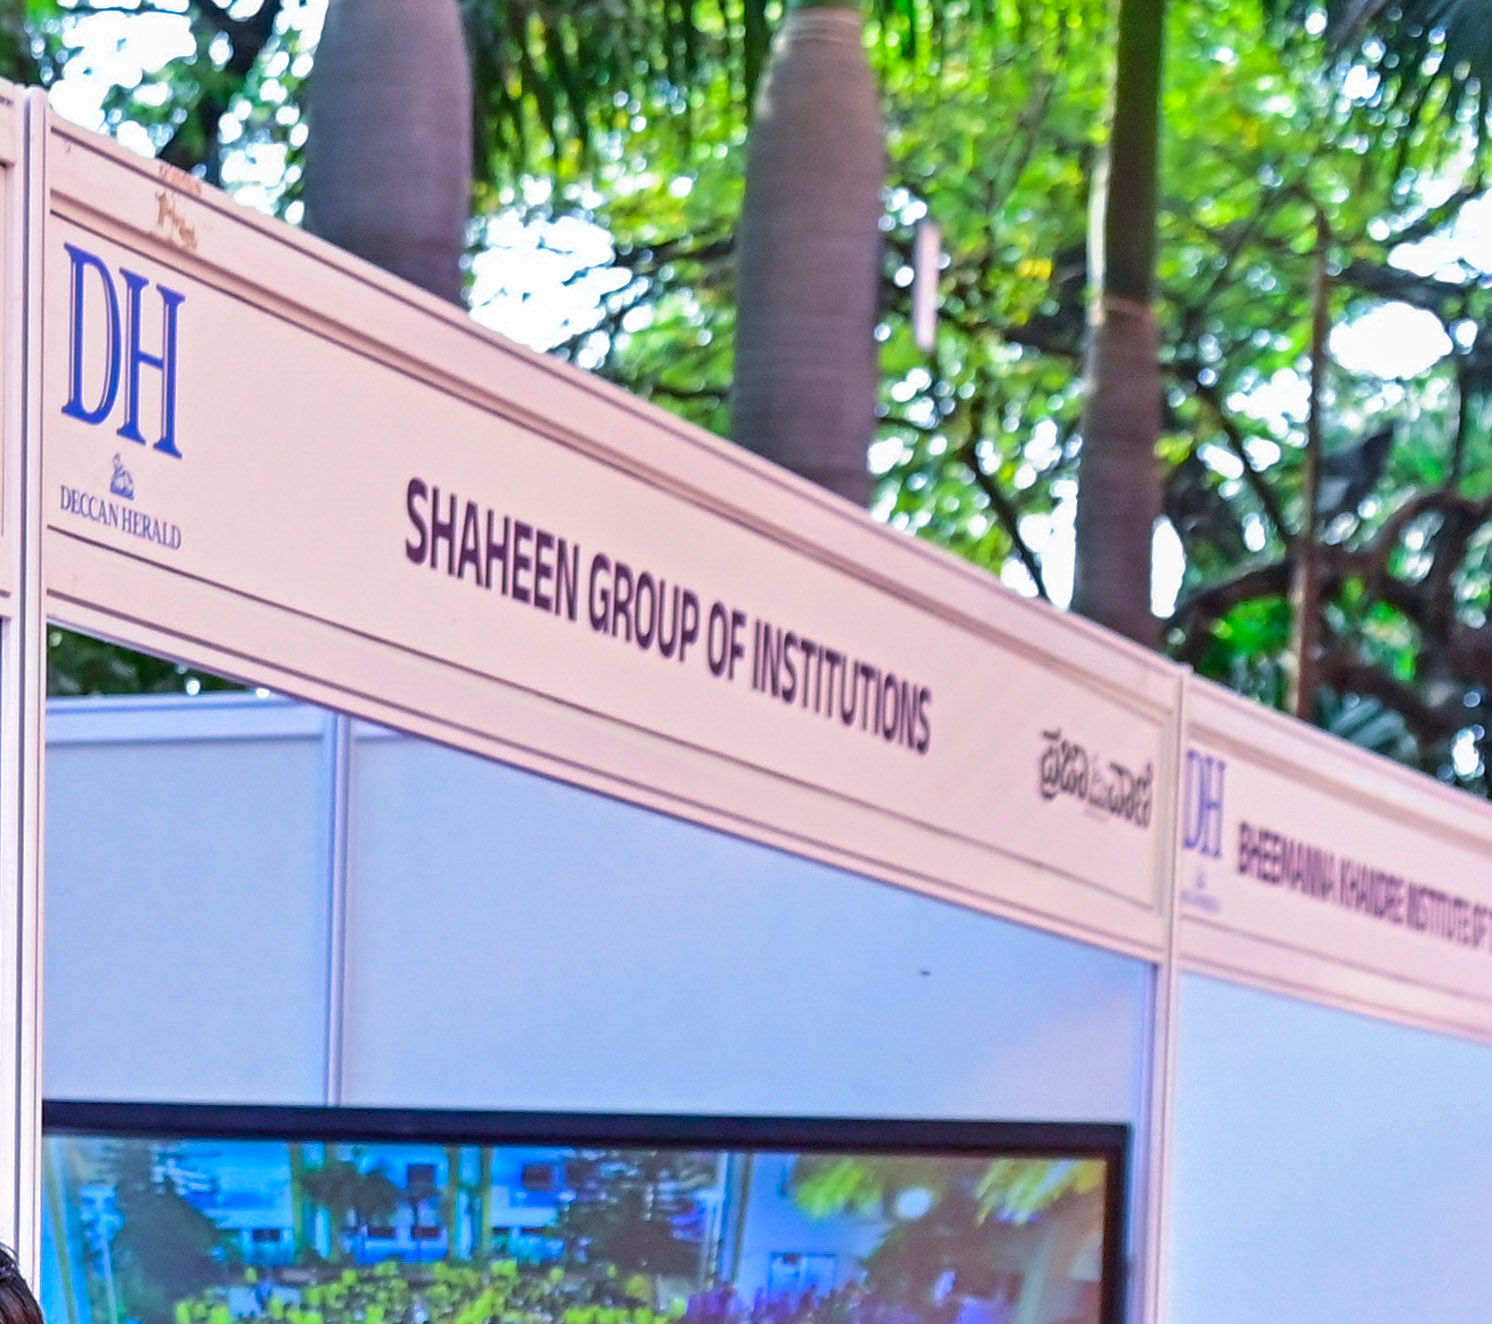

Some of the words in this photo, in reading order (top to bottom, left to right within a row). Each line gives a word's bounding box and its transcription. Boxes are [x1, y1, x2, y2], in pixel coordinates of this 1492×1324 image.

[61, 241, 185, 460] DH
[60, 485, 118, 529] DECCAN
[121, 503, 181, 550] HERALD
[404, 476, 578, 621] SHAHEEN
[588, 553, 697, 663] GROUP
[707, 595, 745, 677] OF
[754, 619, 930, 753] INSTITUTIONS
[1181, 749, 1226, 859] DH
